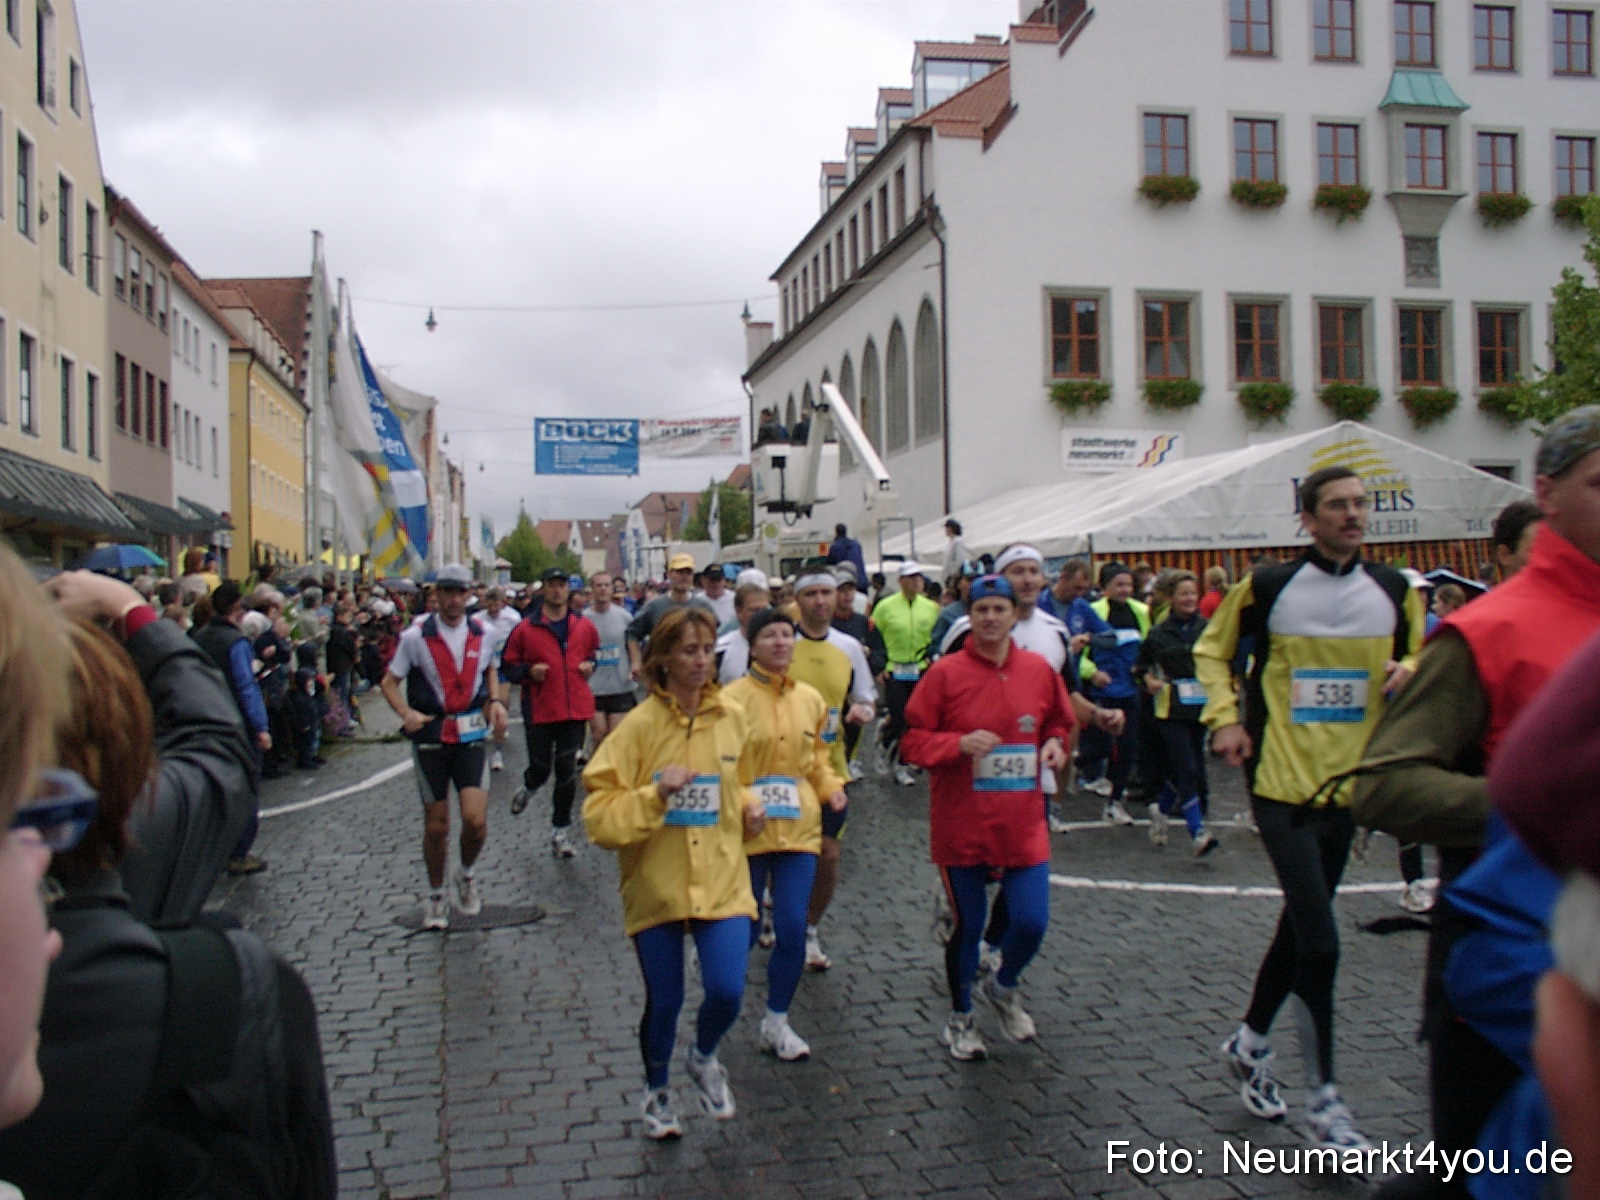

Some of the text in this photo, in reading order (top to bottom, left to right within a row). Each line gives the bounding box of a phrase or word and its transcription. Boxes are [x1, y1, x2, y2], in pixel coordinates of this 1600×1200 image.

[1071, 438, 1136, 448] stadtwerke
[1067, 450, 1125, 460] neumarkt
[1315, 682, 1352, 705] 538
[993, 757, 1025, 777] 549
[673, 787, 711, 808] 555
[761, 787, 790, 804] 554
